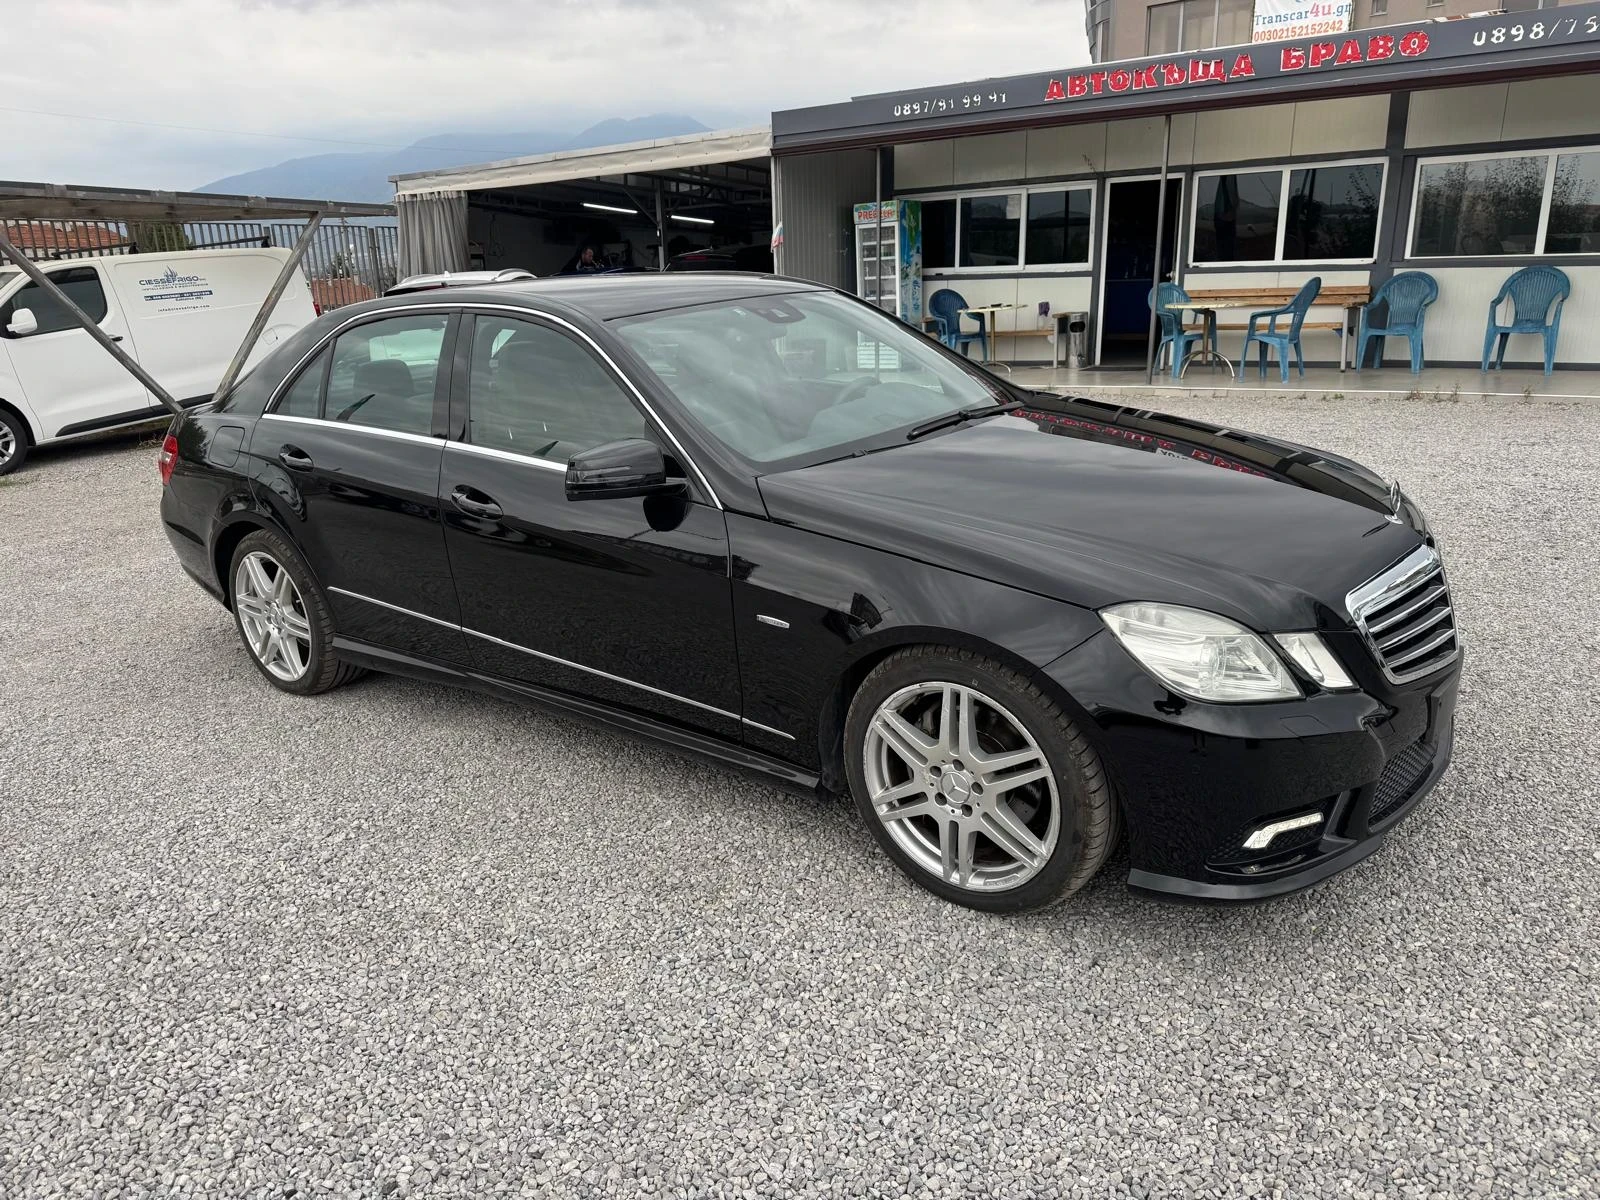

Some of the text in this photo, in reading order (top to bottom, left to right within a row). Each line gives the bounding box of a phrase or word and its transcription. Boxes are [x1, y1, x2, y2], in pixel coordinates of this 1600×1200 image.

[1254, 2, 1352, 26] Transcar4u.gr
[1253, 20, 1343, 42] 00302152152242
[1043, 30, 1430, 101] АВТОКЪЩА БРАВО
[962, 93, 982, 108] 99
[139, 275, 199, 286] CIESSEFRIGO
